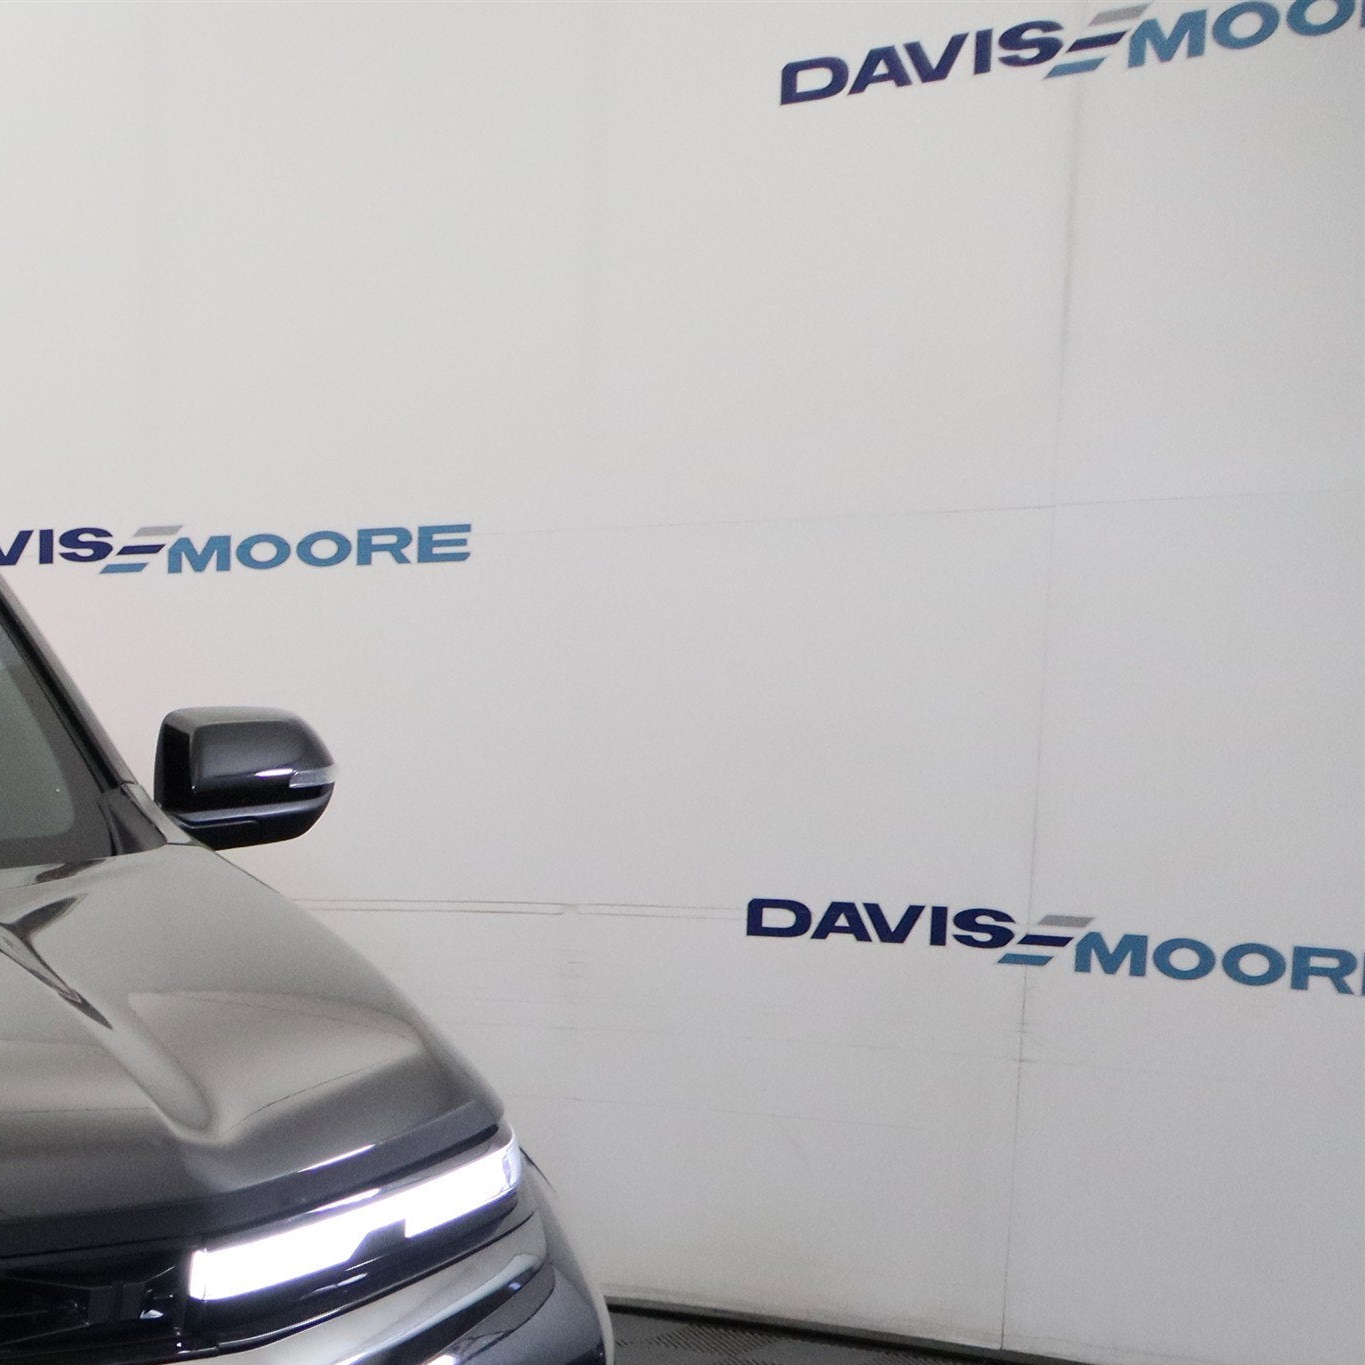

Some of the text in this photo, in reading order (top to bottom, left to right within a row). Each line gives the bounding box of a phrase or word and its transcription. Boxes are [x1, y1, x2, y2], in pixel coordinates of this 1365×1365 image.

[779, 0, 1365, 106] DAVIS MOO
[167, 523, 472, 575] MOORE
[745, 897, 1365, 997] DAVIS MOOR
